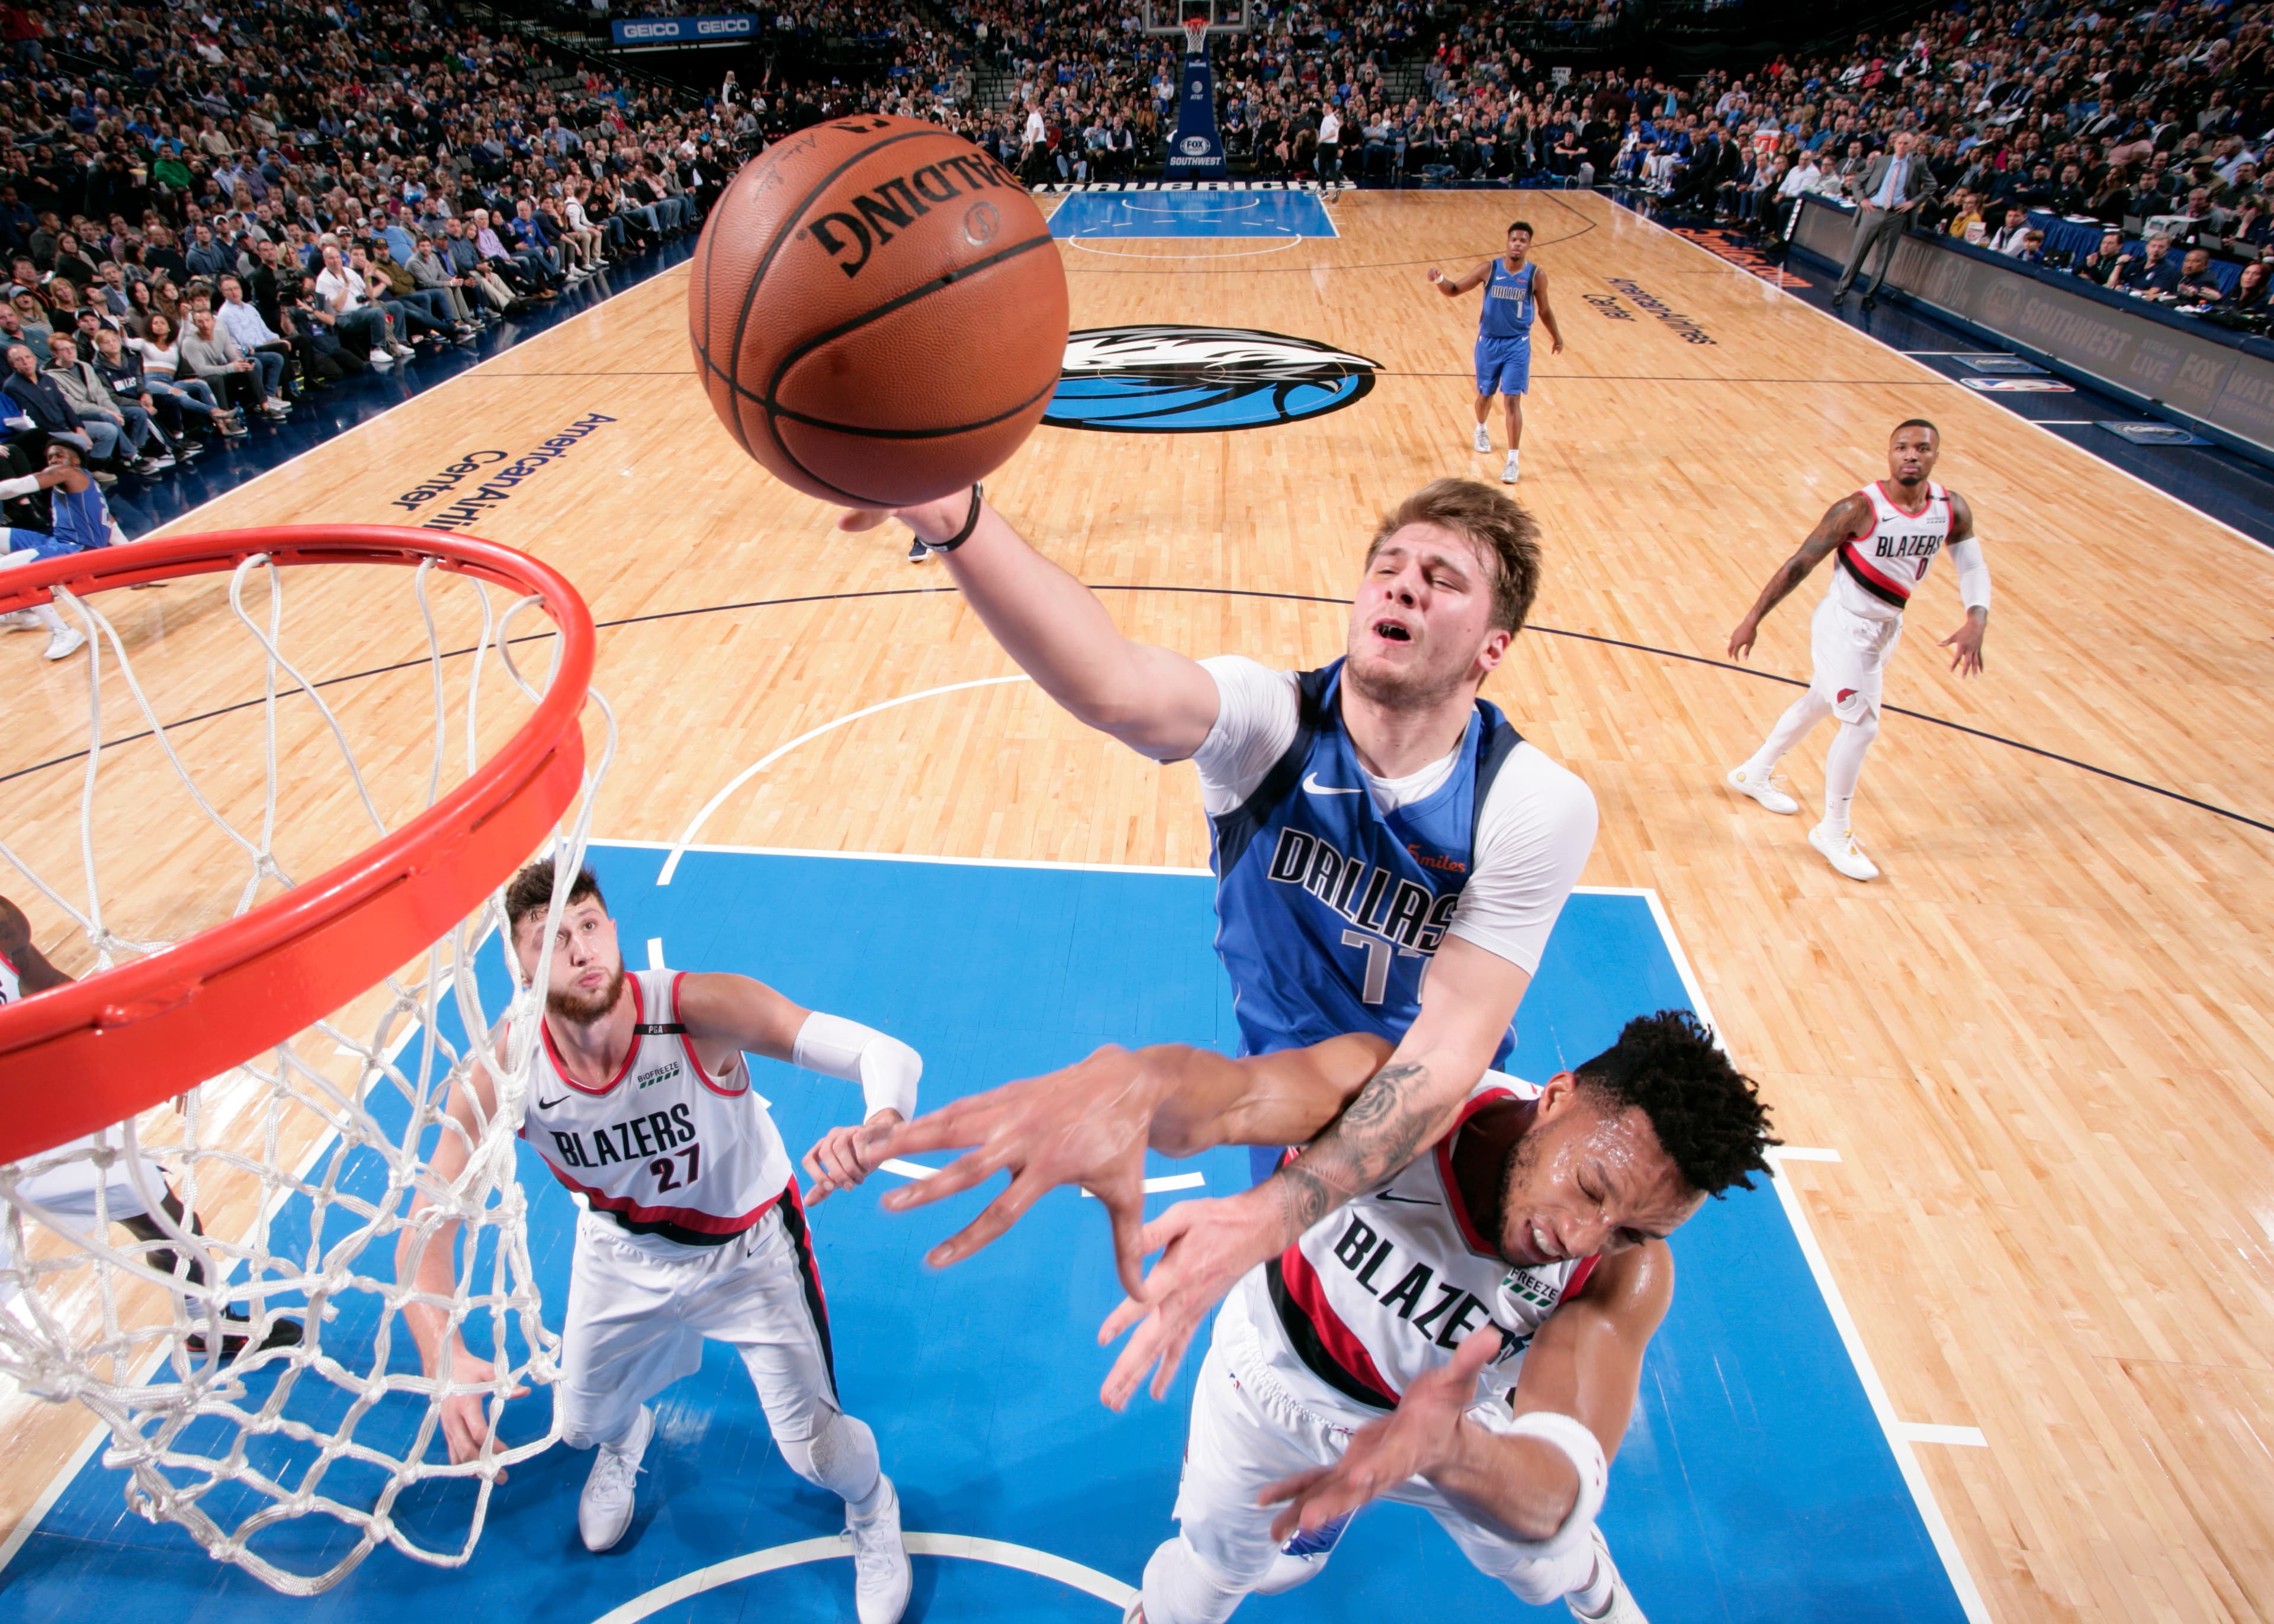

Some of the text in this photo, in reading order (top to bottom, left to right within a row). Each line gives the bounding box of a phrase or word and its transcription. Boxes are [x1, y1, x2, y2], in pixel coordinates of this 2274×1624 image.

[624, 18, 750, 38] GEICO GEICO
[1170, 156, 1221, 166] SOUTHWEST
[809, 152, 1029, 279] PALDING
[1491, 285, 1526, 300] DALLAS
[1990, 284, 2018, 309] FOX
[1517, 301, 1523, 319] 1
[1582, 294, 1637, 321] Center
[2020, 297, 2132, 361] SOUTHWEST
[2141, 337, 2180, 359] STREAM
[2129, 352, 2170, 383] LIVE
[2178, 352, 2226, 389] FOX
[391, 450, 508, 512] Center
[1875, 535, 1945, 558] BLAZERS
[1916, 557, 1929, 581] 0
[1267, 827, 1459, 953] DALLAS
[648, 1025, 663, 1034] PGA
[548, 1103, 696, 1168] BLAZERS
[649, 1141, 700, 1194] 27
